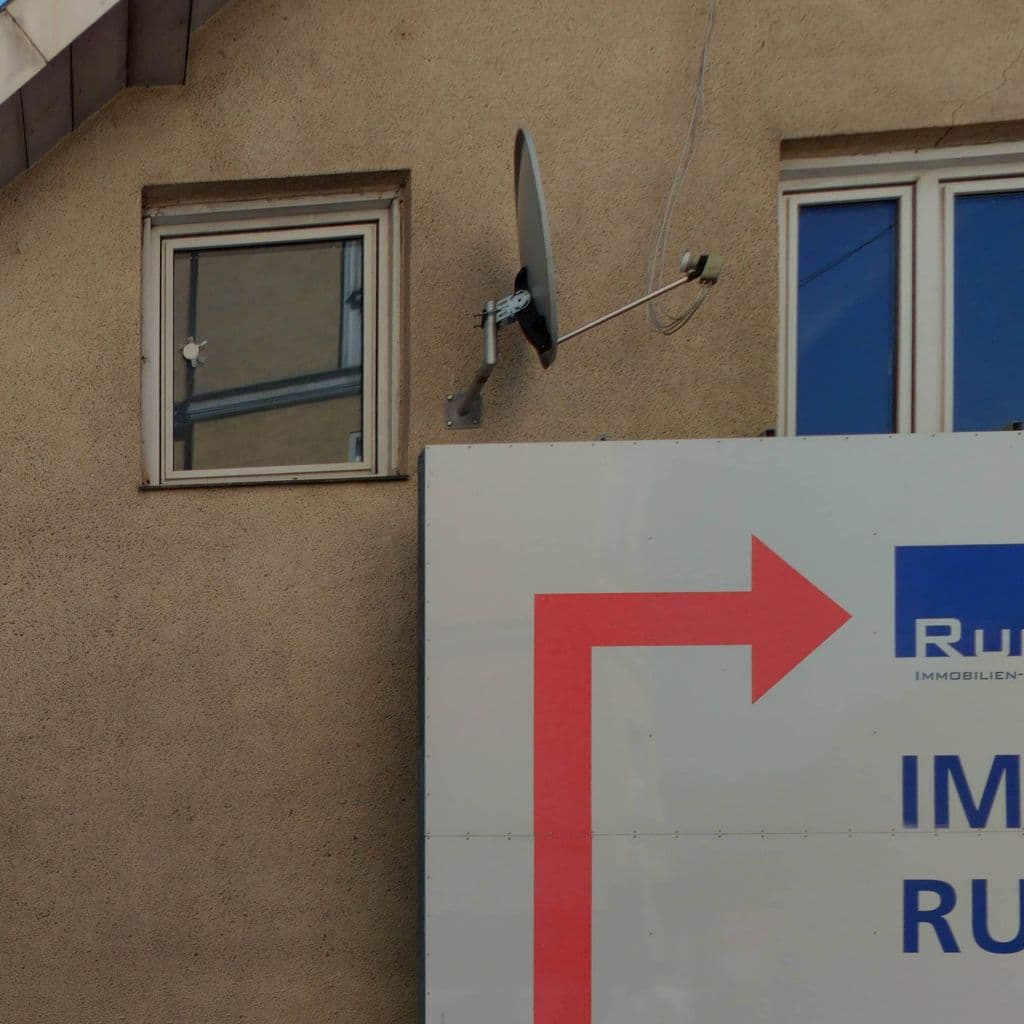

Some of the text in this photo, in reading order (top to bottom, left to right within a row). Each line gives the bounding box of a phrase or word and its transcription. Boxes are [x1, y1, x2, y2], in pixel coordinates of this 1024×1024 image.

[914, 617, 1024, 658] Ru
[902, 754, 1022, 829] IM
[902, 878, 1024, 954] RU
